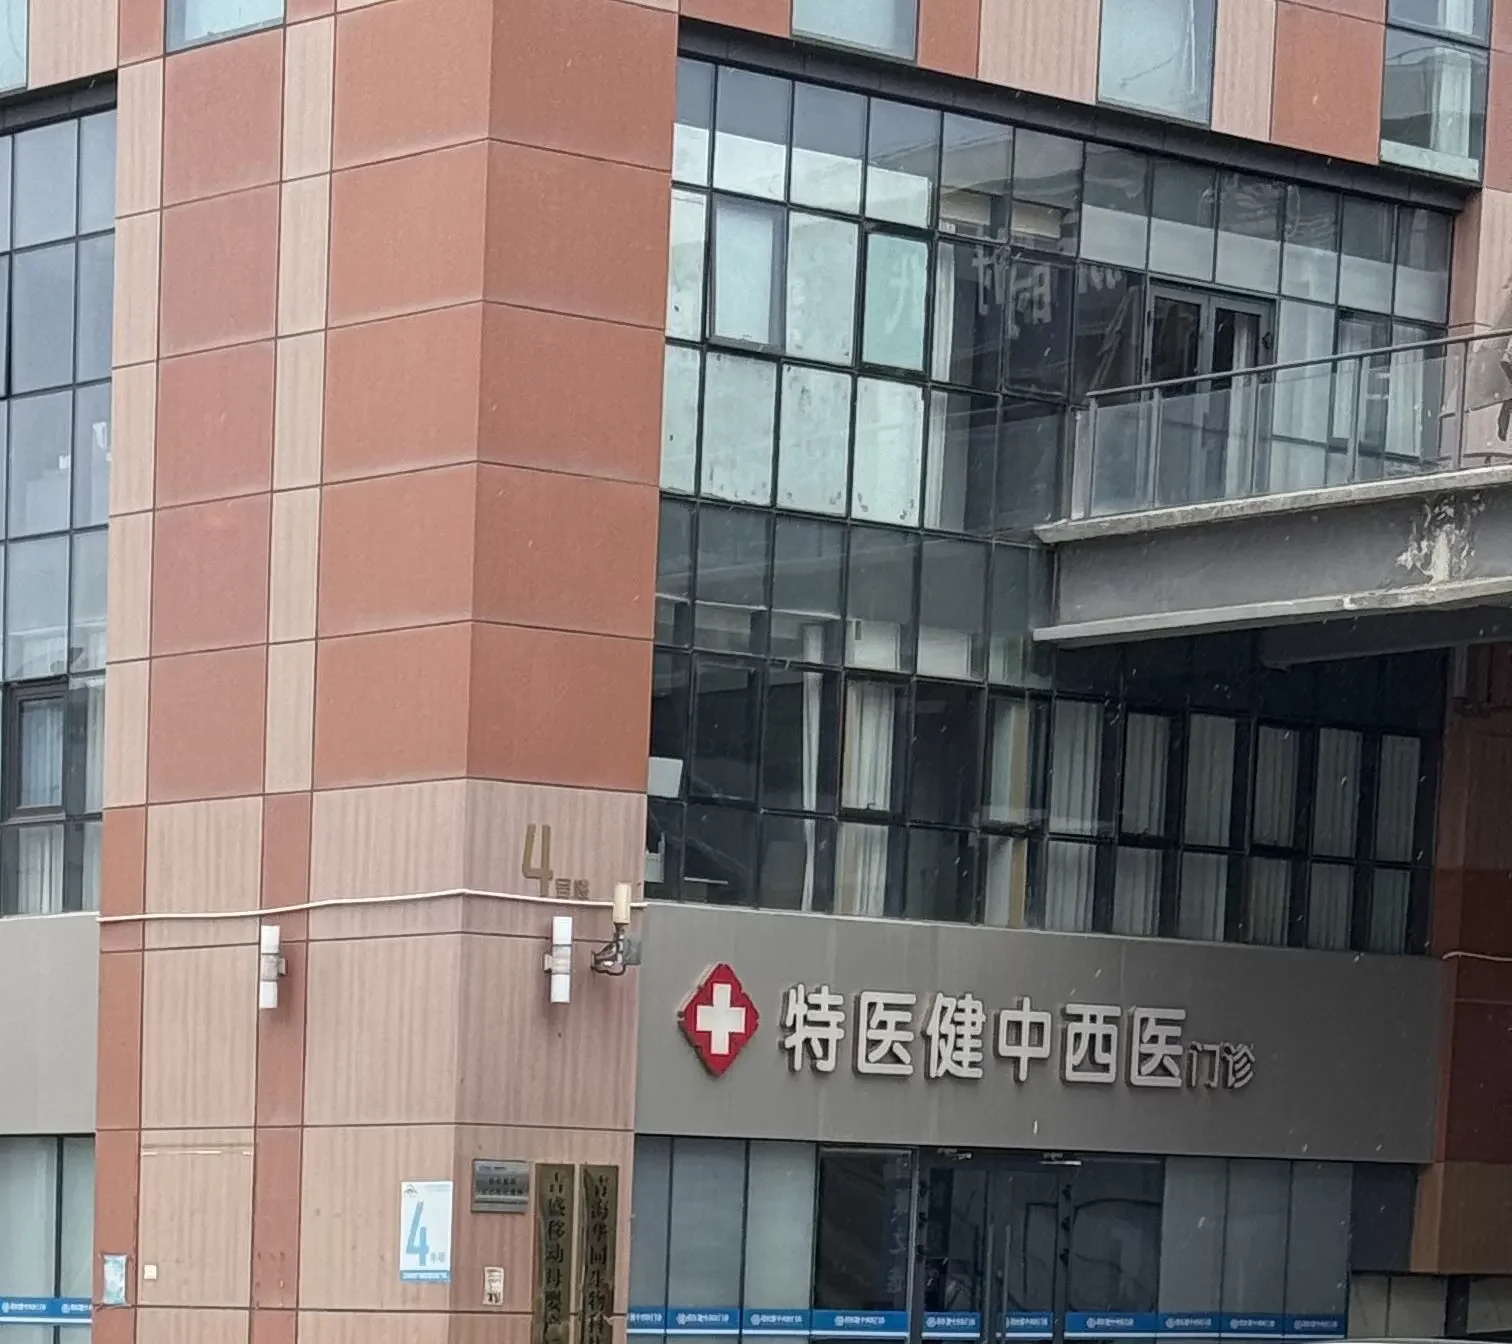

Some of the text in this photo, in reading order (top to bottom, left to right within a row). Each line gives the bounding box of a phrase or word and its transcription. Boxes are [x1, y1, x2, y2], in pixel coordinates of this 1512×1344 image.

[781, 983, 1257, 1090] 特医健中西医门诊
